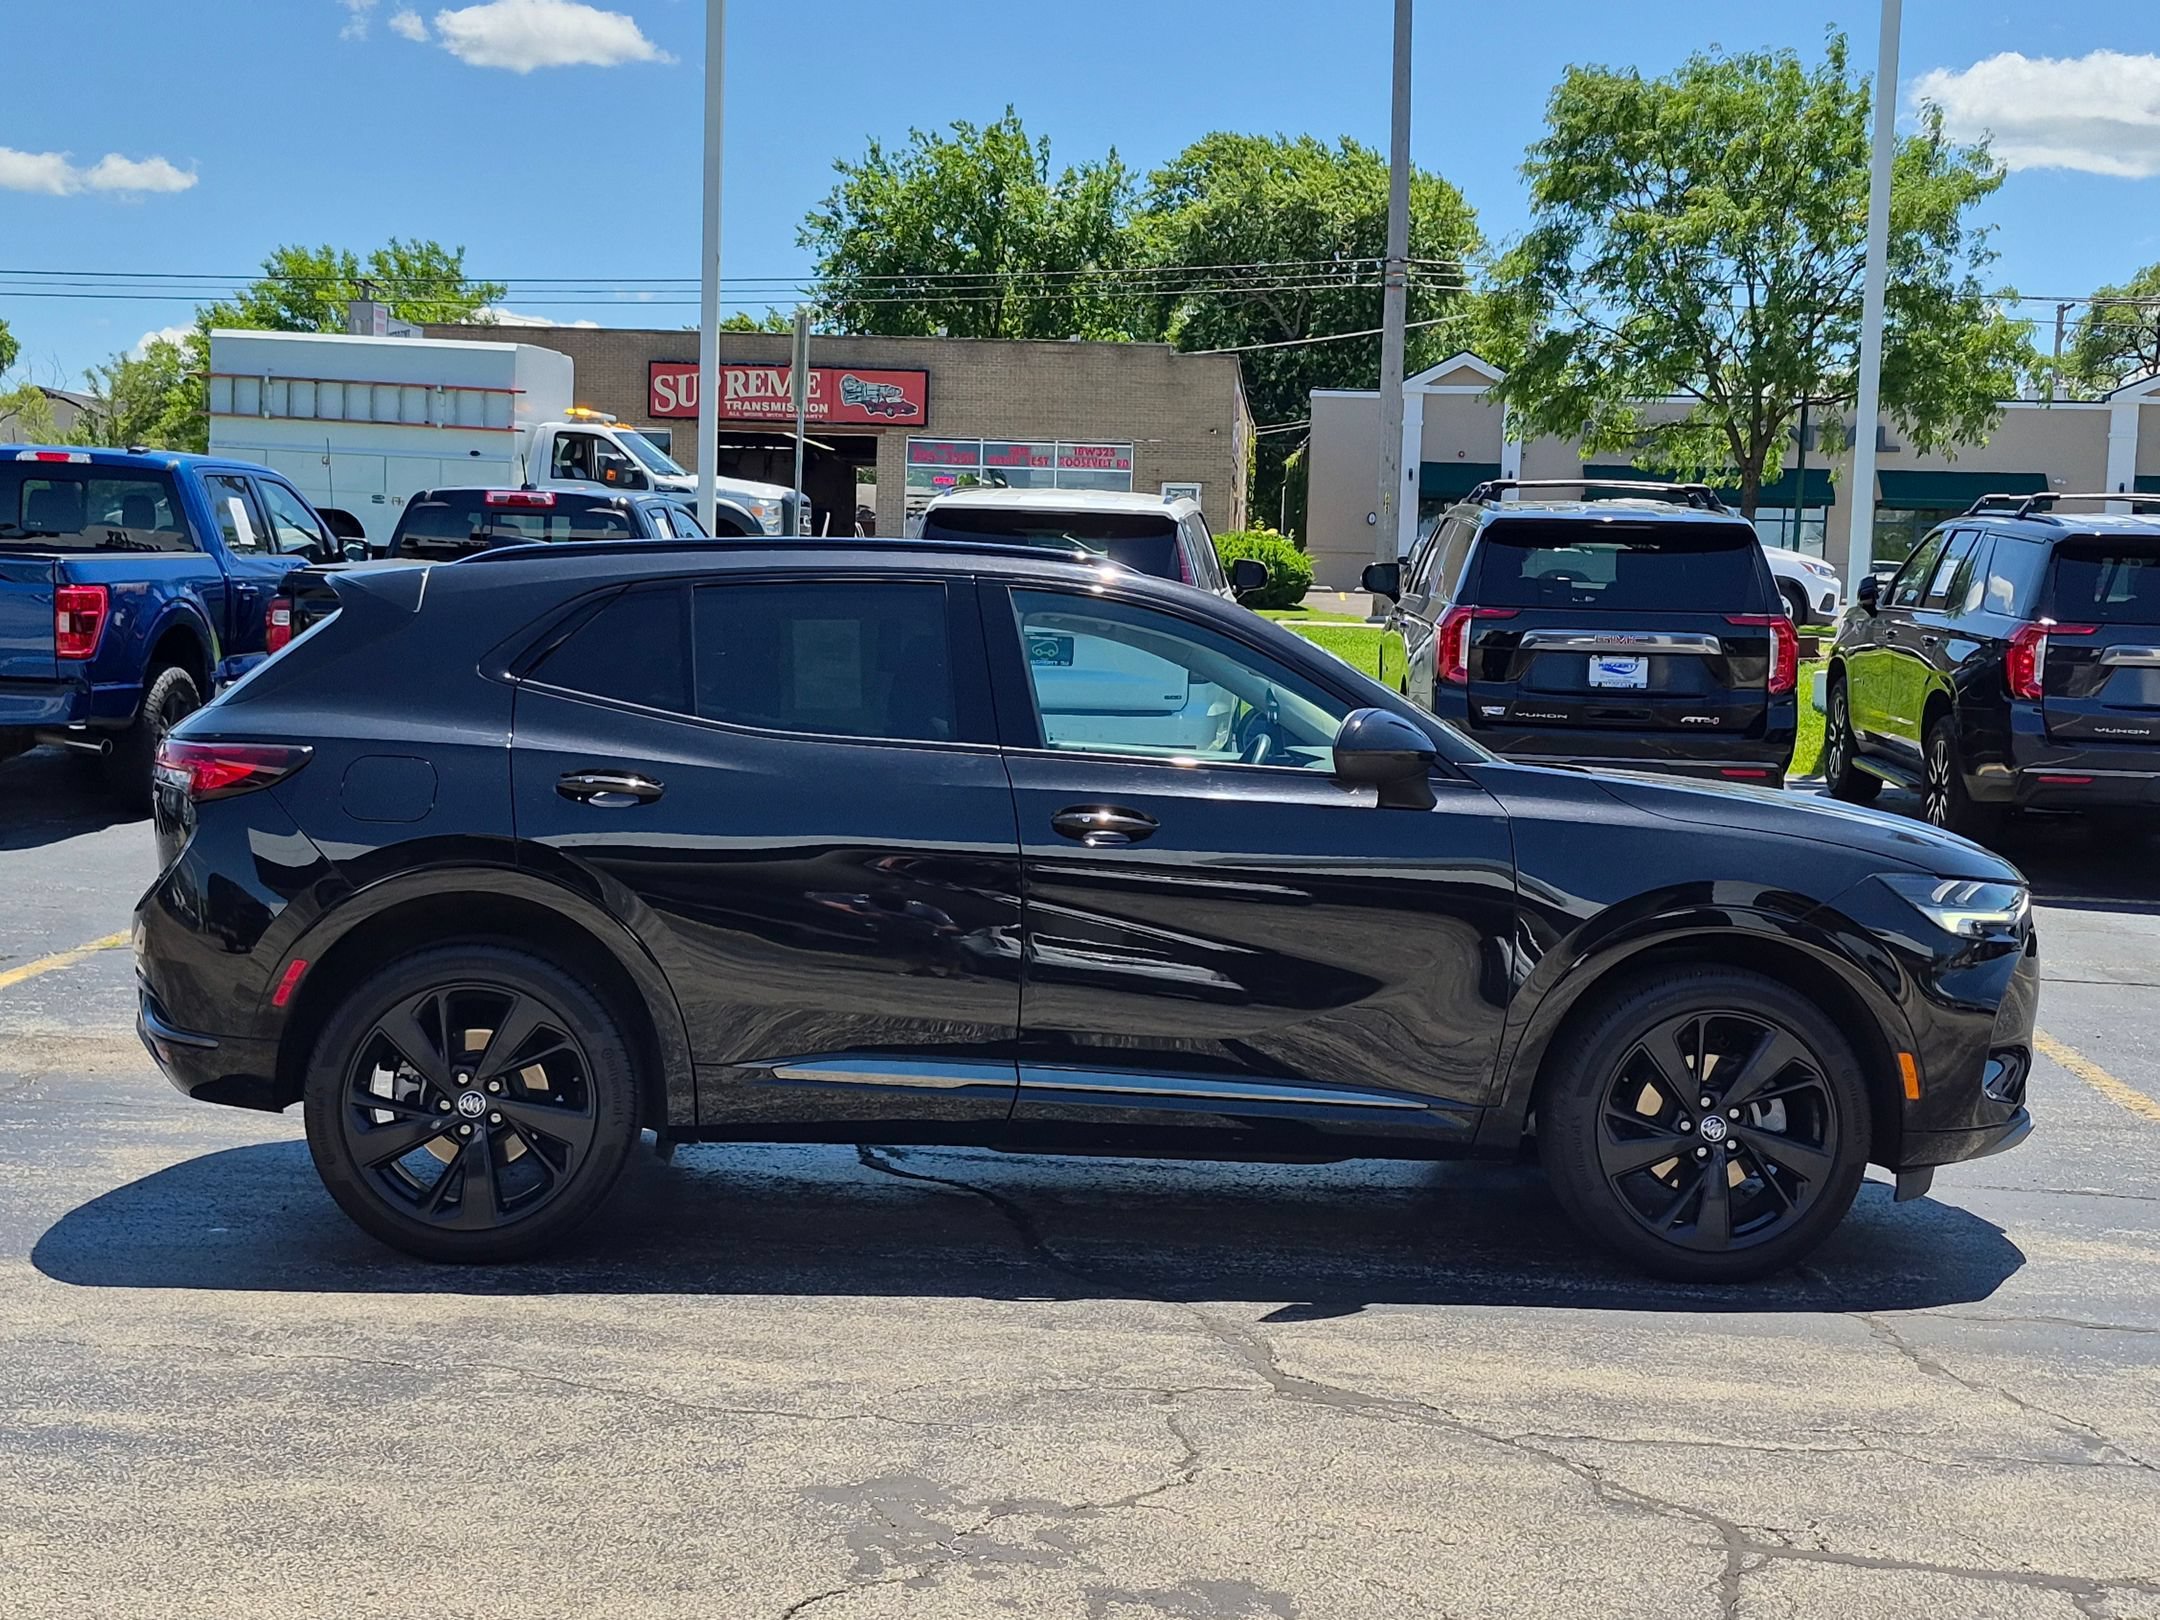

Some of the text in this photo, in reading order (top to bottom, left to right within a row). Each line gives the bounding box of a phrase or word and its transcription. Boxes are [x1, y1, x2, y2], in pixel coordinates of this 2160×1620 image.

[654, 369, 820, 413] SUREME
[724, 400, 829, 414] TRANSMISION
[1059, 456, 1112, 468] ROOSEVELT
[1515, 711, 1568, 719] YUKON
[2094, 727, 2150, 735] YUKON
